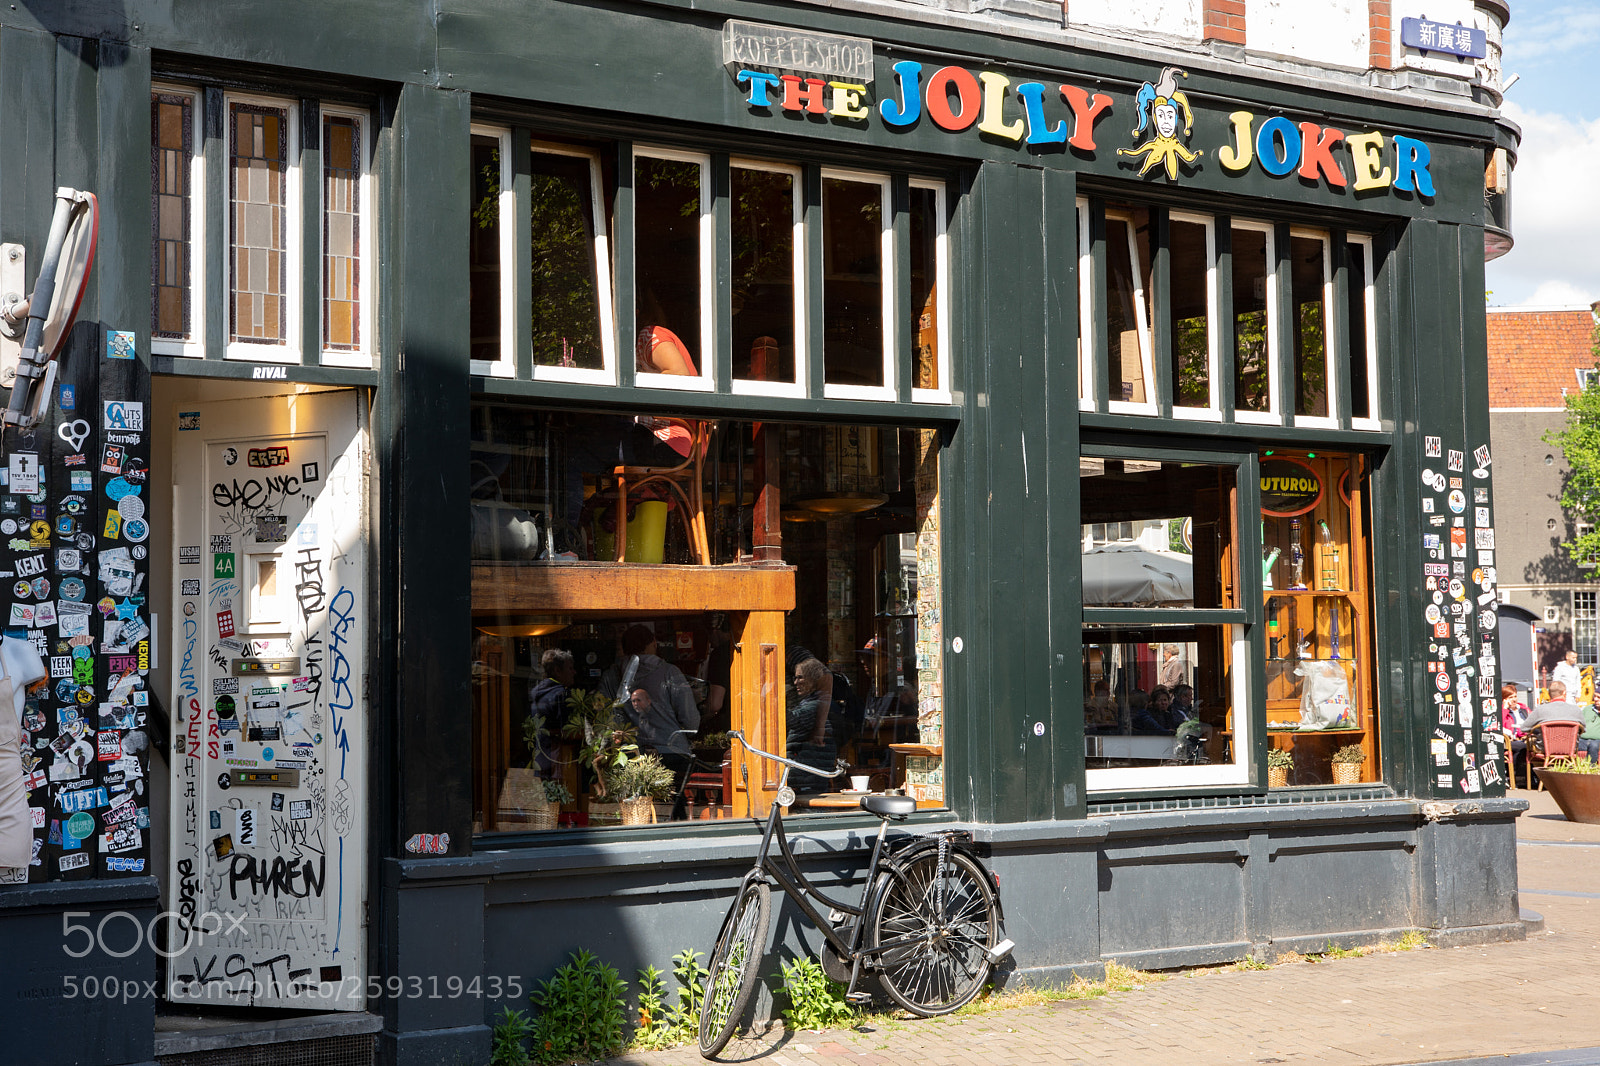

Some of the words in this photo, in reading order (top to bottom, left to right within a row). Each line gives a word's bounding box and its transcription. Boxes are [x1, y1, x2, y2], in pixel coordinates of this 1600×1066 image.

[1419, 22, 1473, 53] 新廣場
[735, 31, 867, 76] COFFEESHOP
[737, 69, 869, 119] THE
[880, 61, 1114, 151] JOLLY
[1218, 111, 1437, 198] JOKER
[252, 366, 287, 379] RIVAL
[1260, 476, 1319, 492] UTUROLA
[15, 554, 48, 578] KENT
[215, 558, 234, 573] 4A
[51, 657, 71, 669] YEEK
[252, 687, 279, 695] SPORTING
[230, 854, 326, 901] PHREN
